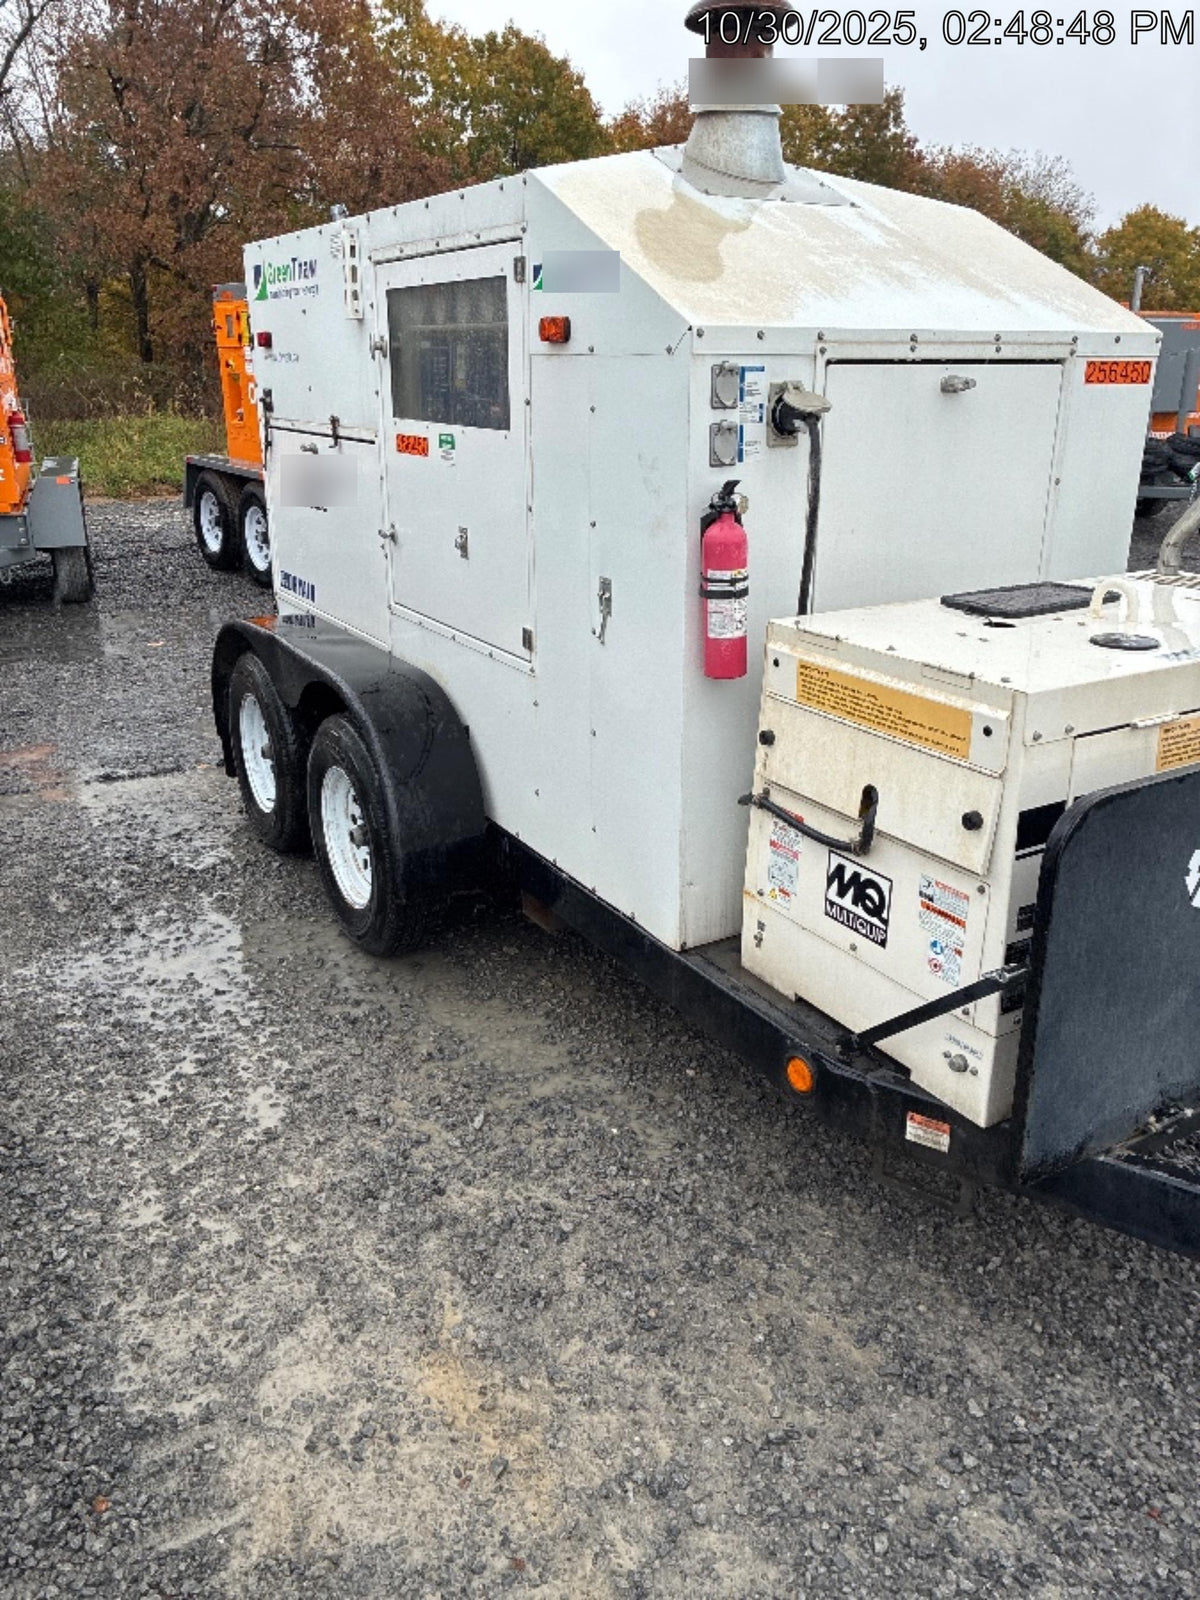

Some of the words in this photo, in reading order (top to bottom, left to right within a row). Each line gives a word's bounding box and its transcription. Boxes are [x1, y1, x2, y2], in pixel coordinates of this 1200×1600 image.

[1086, 361, 1151, 384] 256450
[827, 862, 887, 922] MQ
[826, 900, 887, 945] MULTIQUIP
